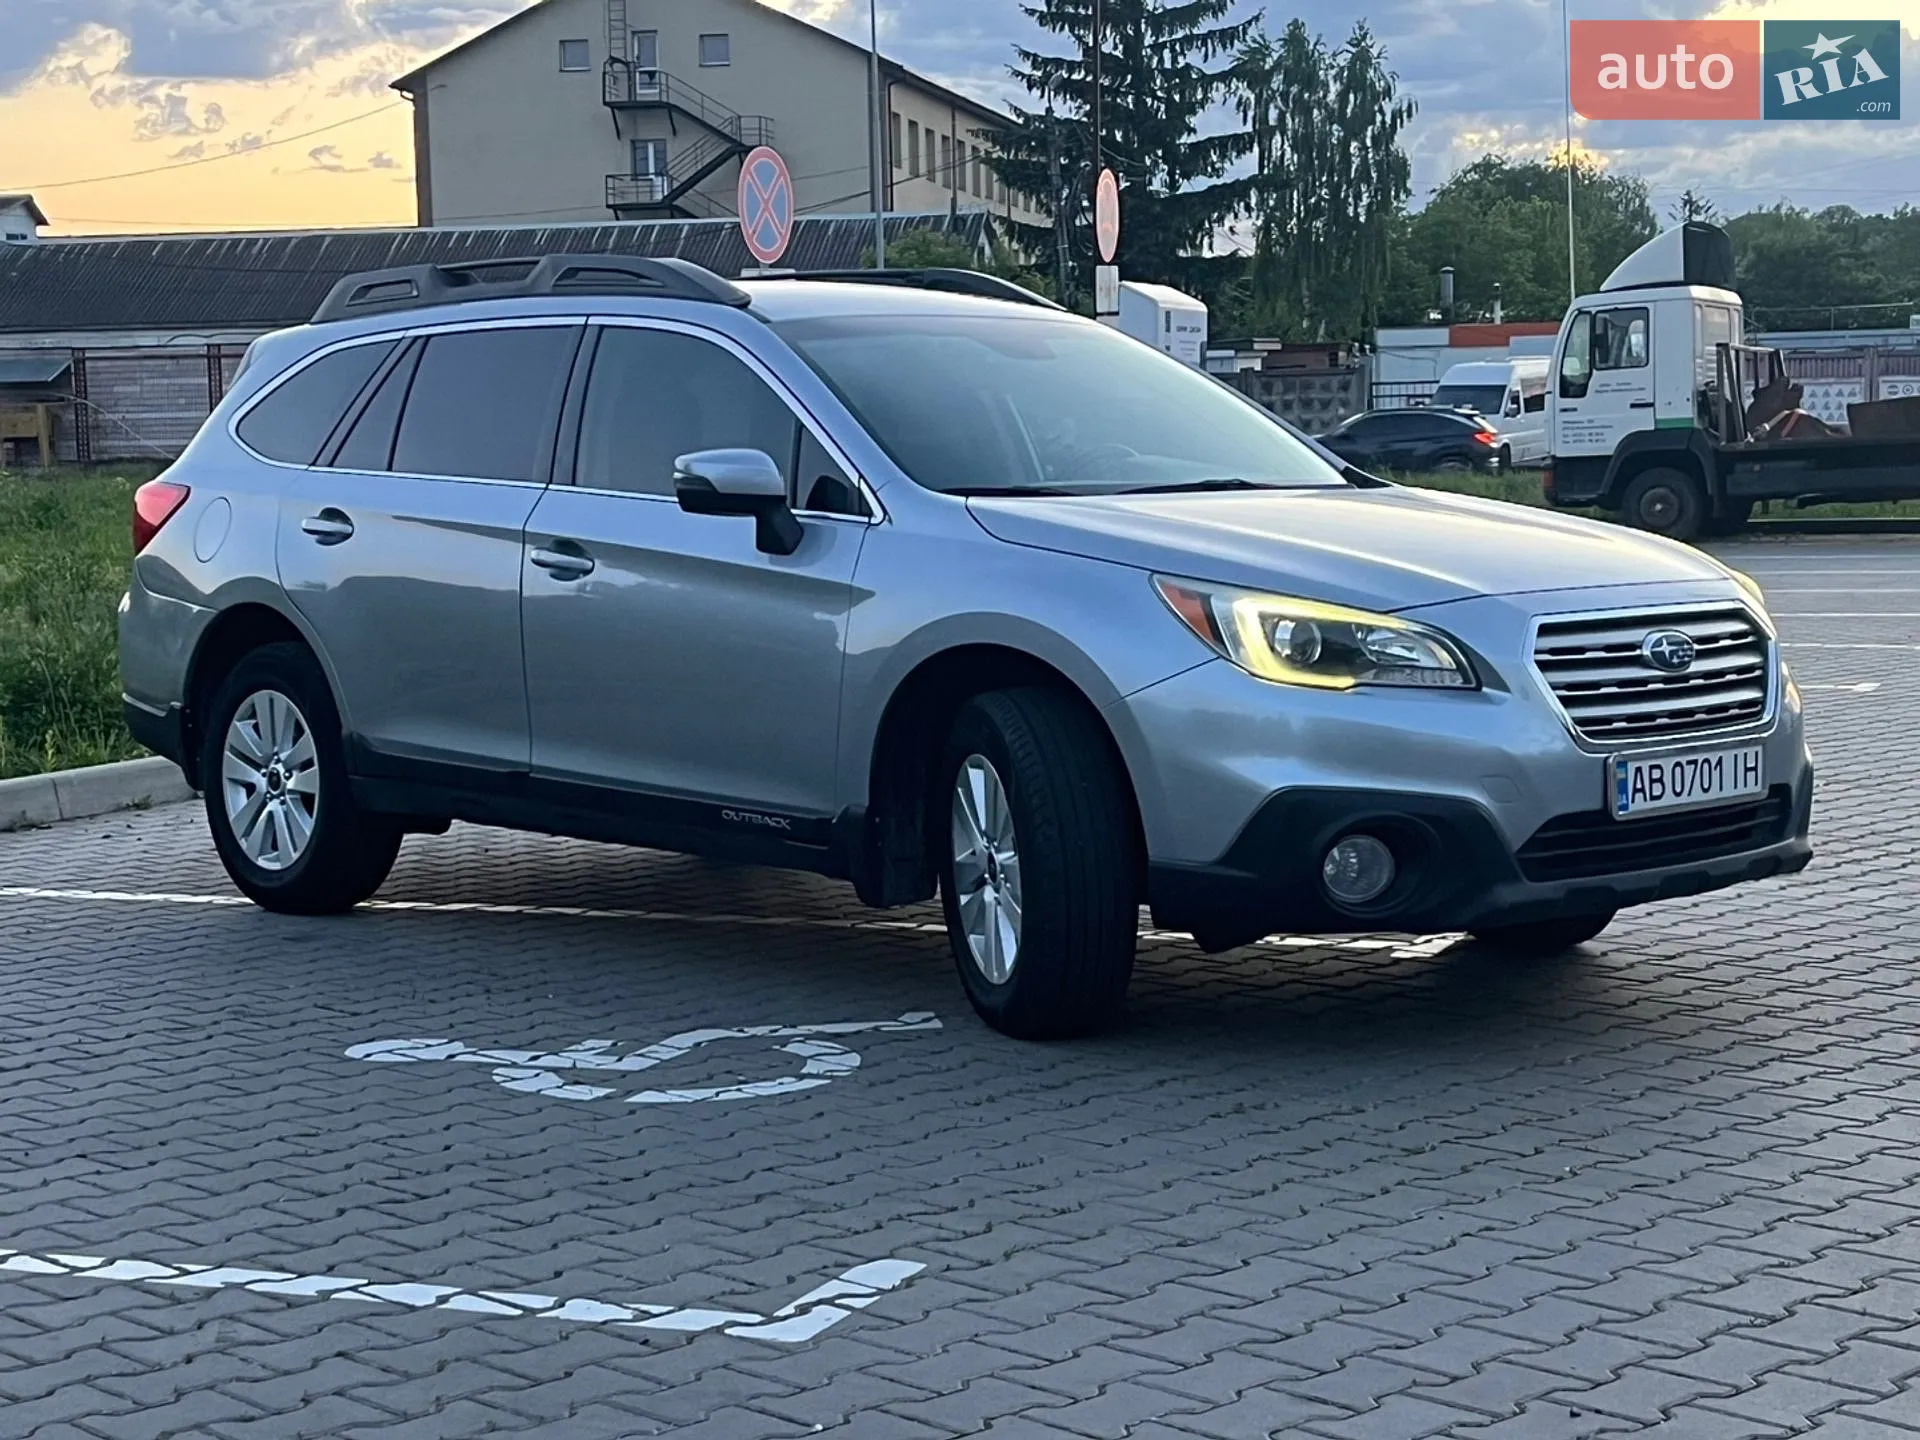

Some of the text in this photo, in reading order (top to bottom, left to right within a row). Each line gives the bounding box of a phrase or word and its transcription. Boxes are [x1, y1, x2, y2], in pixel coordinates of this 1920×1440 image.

[1631, 750, 1759, 804] AB 0701 IH
[721, 809, 792, 831] OUTBACK
